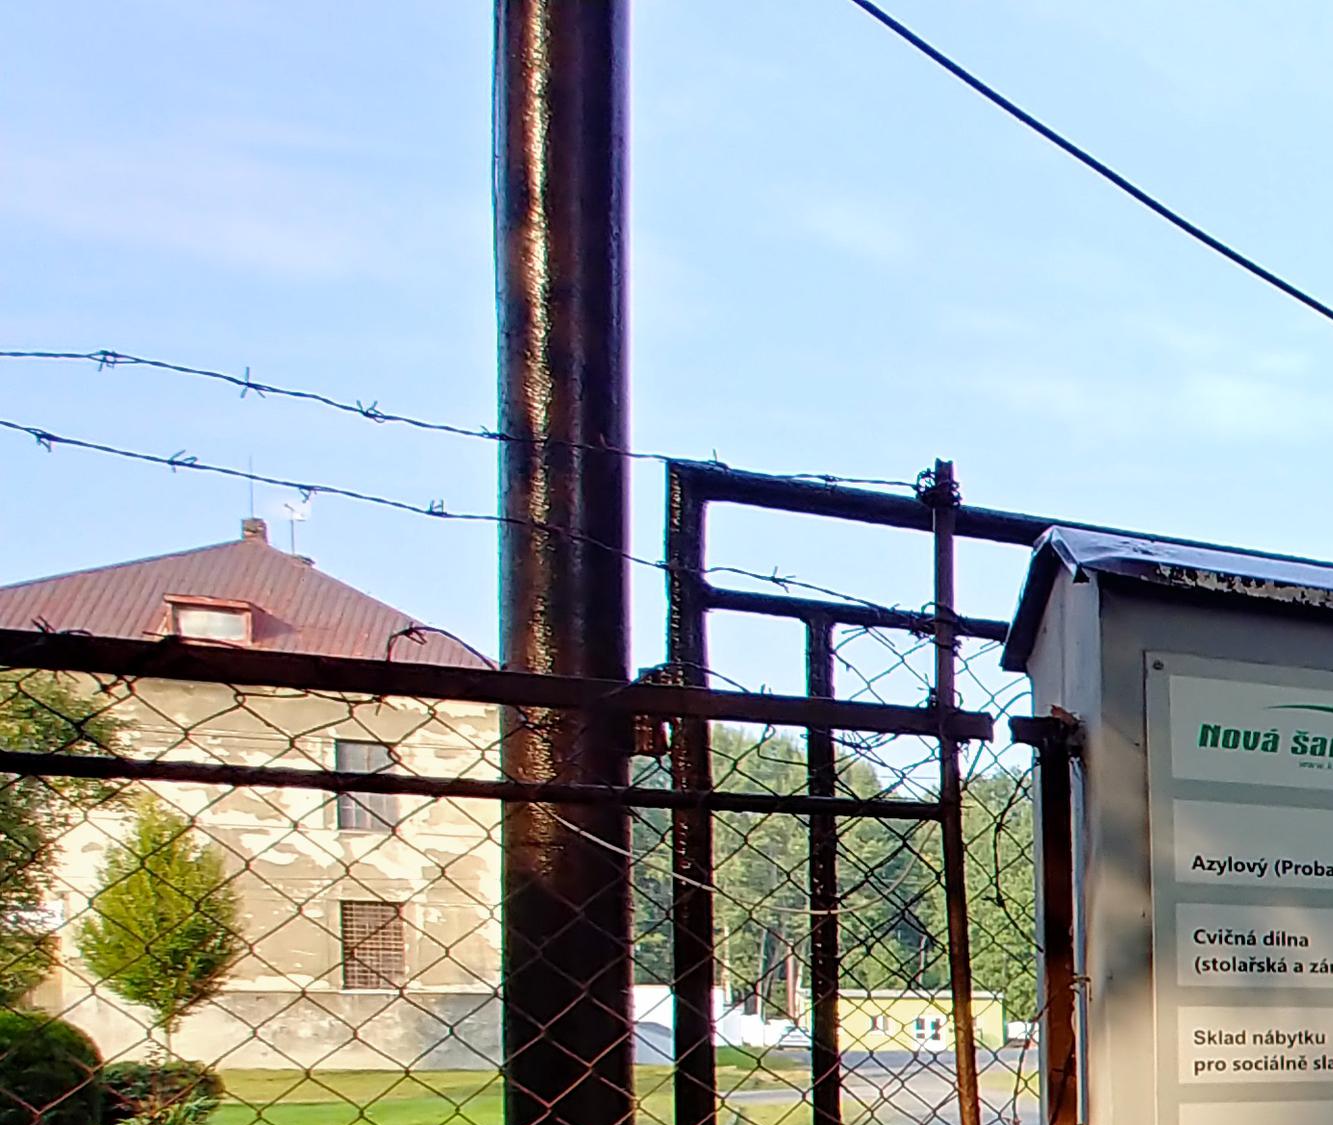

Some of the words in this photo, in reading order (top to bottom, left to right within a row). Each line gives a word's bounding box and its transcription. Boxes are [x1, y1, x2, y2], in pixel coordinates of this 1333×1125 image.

[1198, 723, 1280, 753] Nová
[1192, 855, 1268, 878] Azylový
[1193, 928, 1257, 947] Cvičná
[1262, 930, 1309, 947] dílna
[1194, 957, 1287, 975] (stolařská
[1293, 962, 1304, 974] a
[1193, 1029, 1246, 1046] Sklad
[1252, 1030, 1326, 1048] nábytku
[1194, 1058, 1226, 1076] pro
[1232, 1055, 1308, 1072] sociálně
